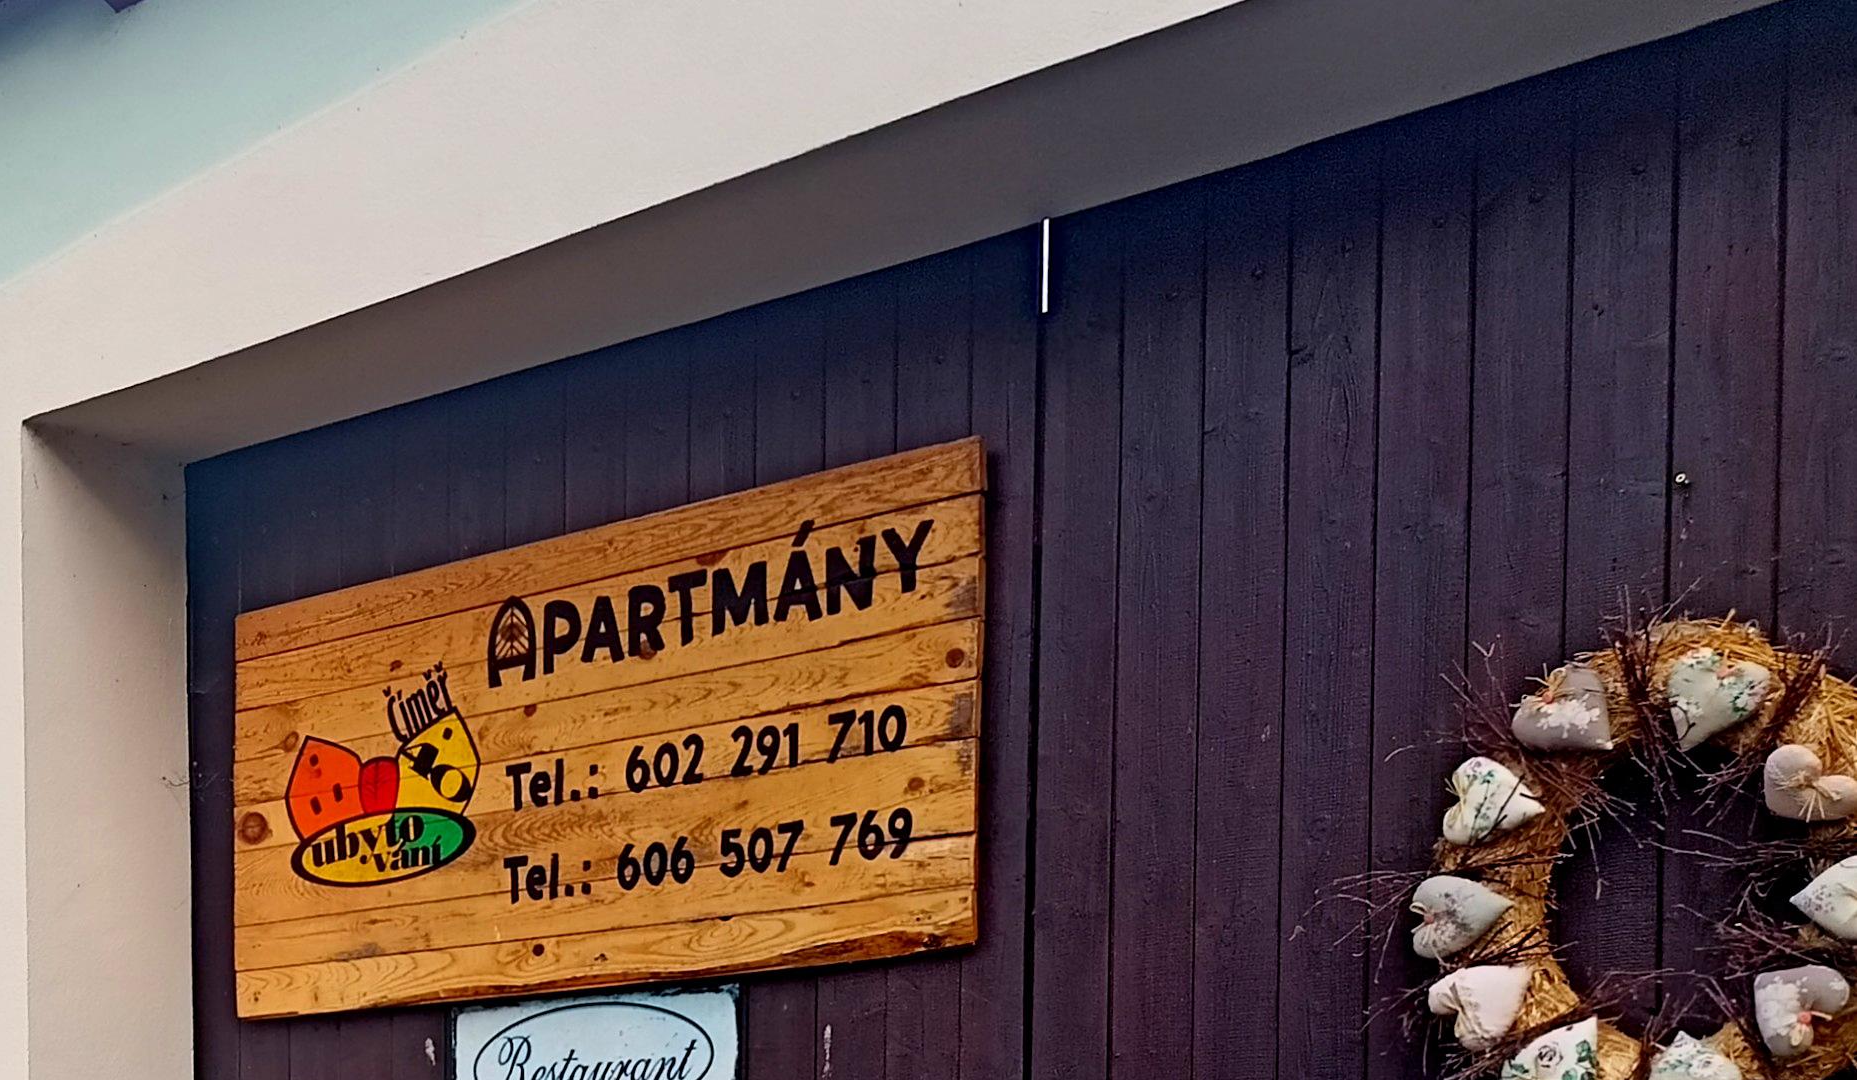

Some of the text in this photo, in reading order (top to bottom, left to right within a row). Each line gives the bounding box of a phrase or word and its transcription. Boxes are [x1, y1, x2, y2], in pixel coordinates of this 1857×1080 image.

[488, 519, 934, 688] APARTMÁNY
[505, 705, 907, 812] Tel.: 602 291 710
[503, 807, 914, 904] Tel.: 606 507 769
